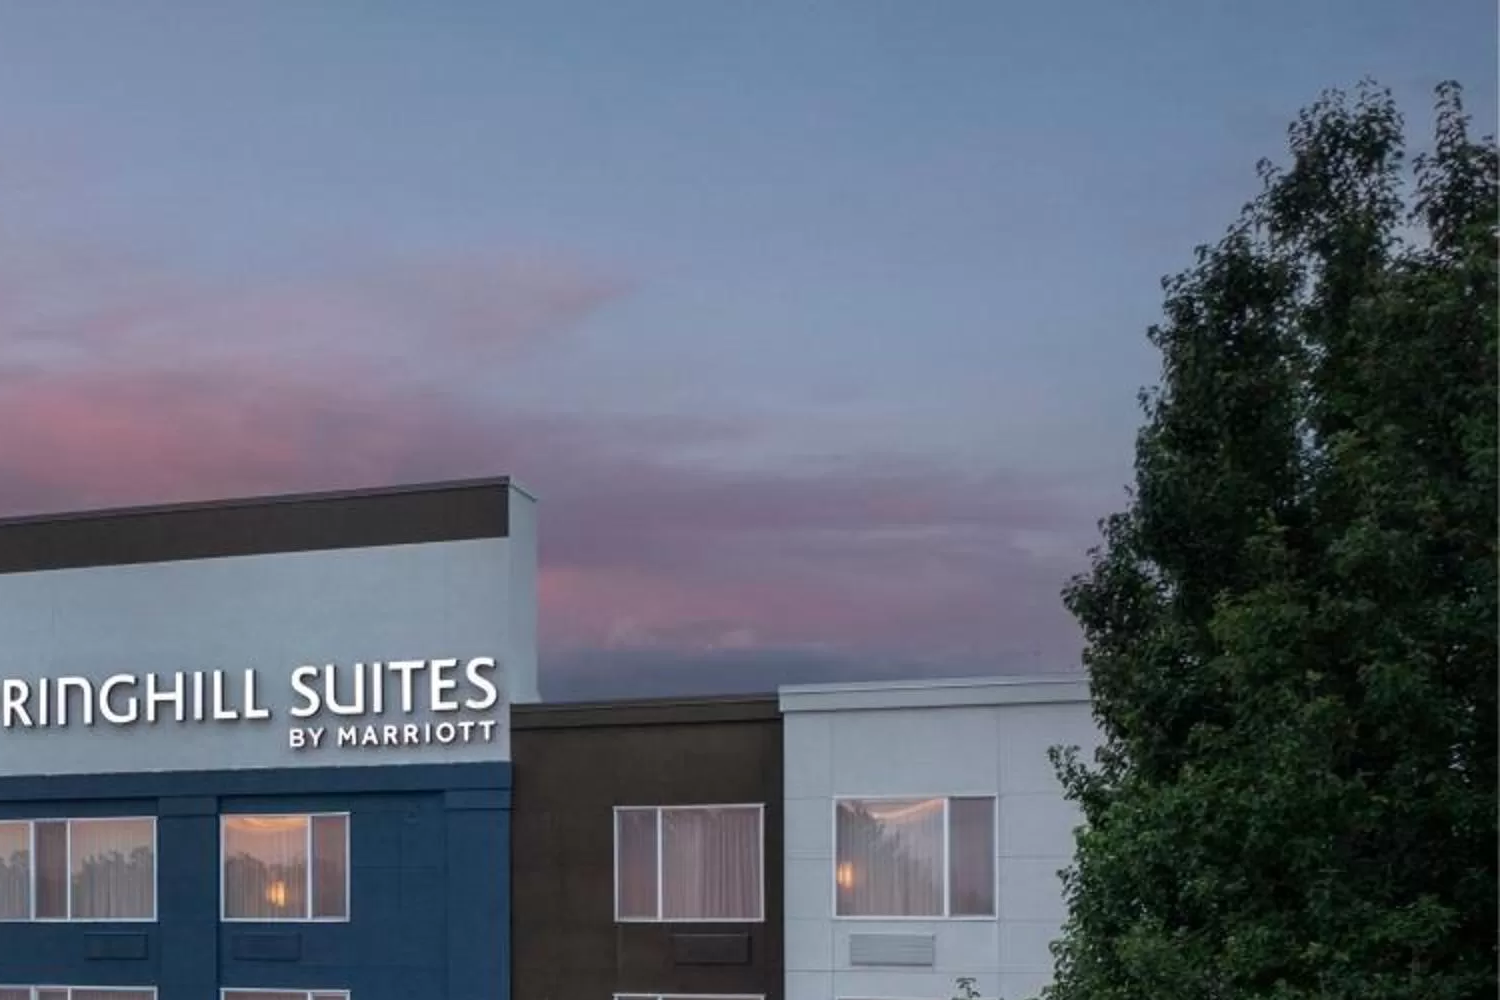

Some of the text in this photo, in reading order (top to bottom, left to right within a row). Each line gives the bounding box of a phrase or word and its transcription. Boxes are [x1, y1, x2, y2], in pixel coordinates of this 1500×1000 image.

[290, 656, 498, 718] SUITES
[289, 719, 497, 748] BY MARRIOTT
